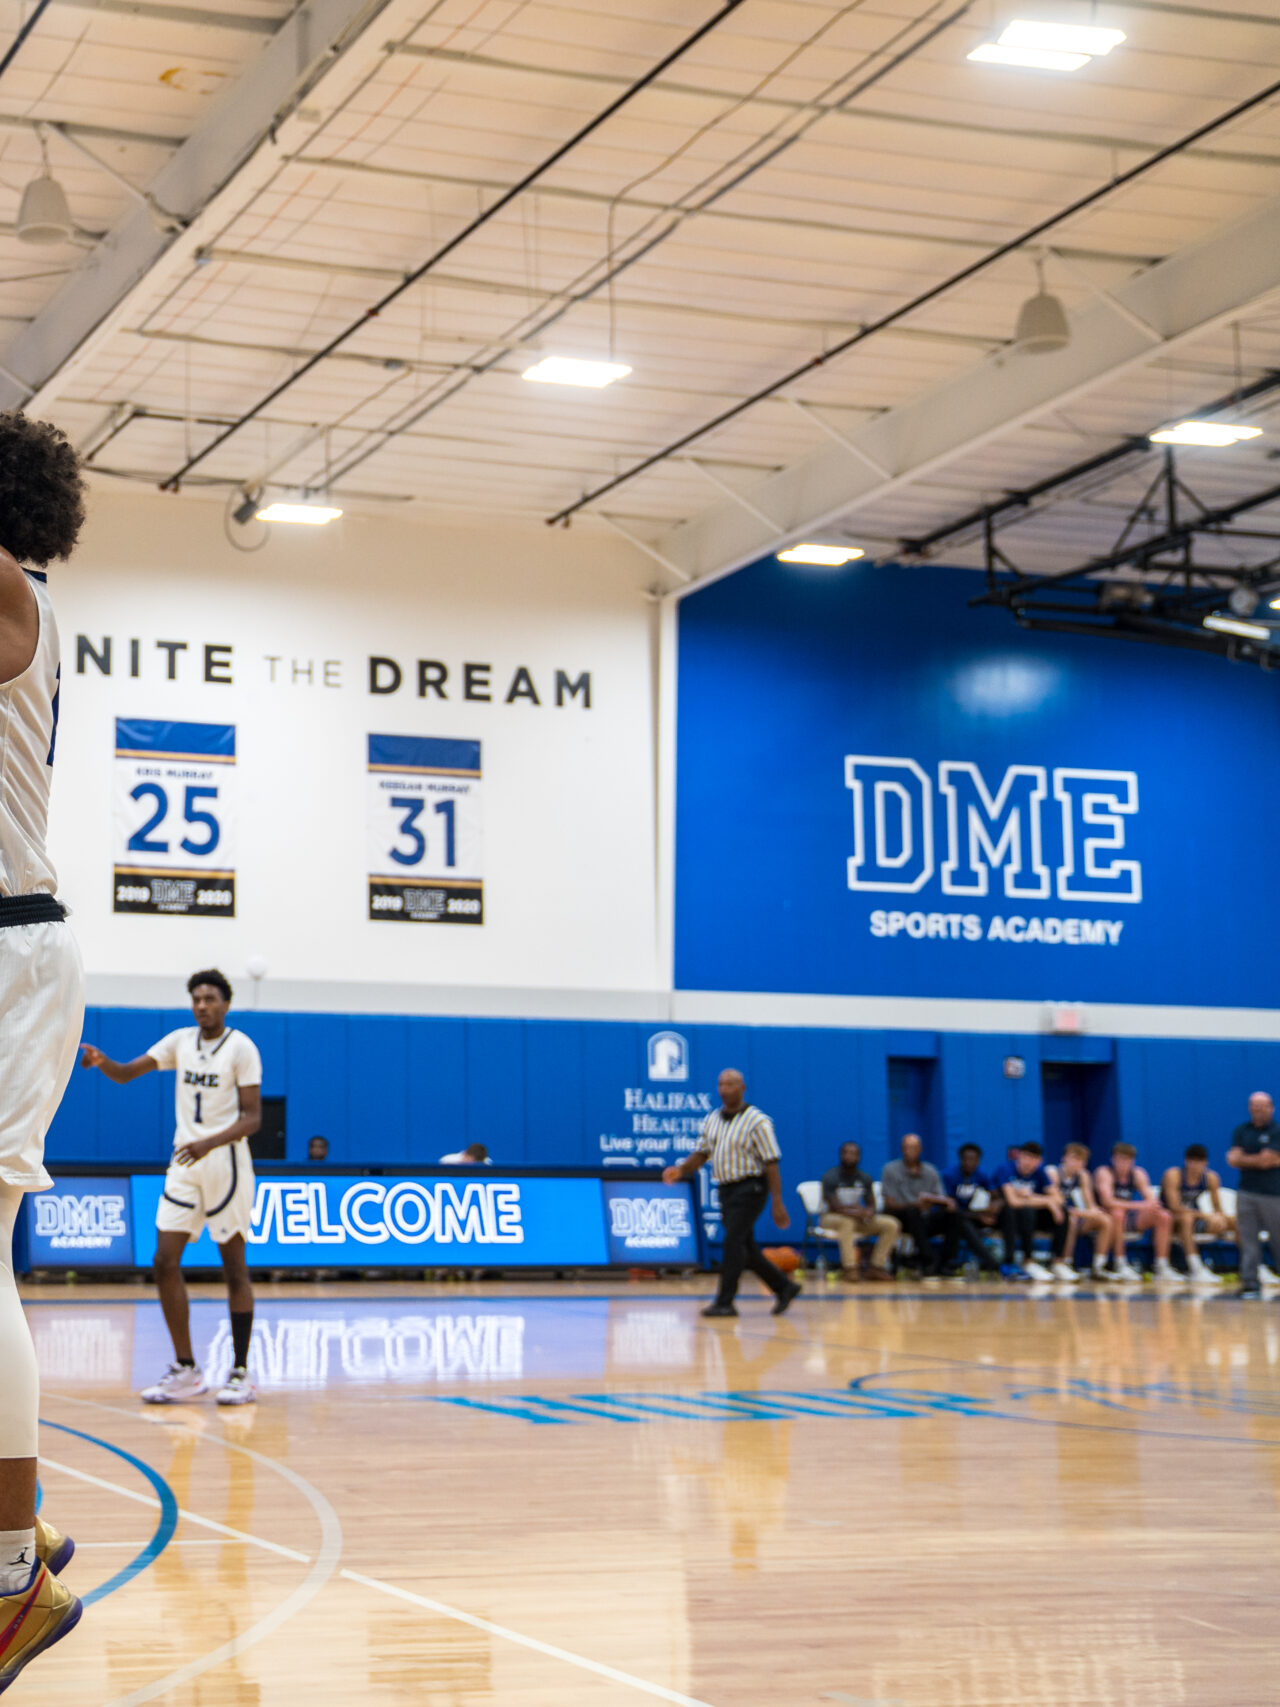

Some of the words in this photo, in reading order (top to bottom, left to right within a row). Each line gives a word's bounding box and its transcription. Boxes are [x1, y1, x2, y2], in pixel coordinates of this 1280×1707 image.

[264, 655, 342, 688] THE
[368, 655, 592, 709] DREAM
[128, 782, 220, 856] 25
[389, 797, 456, 867] 31
[844, 754, 1143, 904] DME
[151, 879, 197, 905] DME
[404, 888, 447, 913] DME
[870, 910, 982, 941] SPORTS
[987, 915, 1123, 946] ACADEMY
[183, 1070, 219, 1088] DME
[194, 1091, 202, 1124] 1
[624, 1087, 712, 1112] HALIFAX
[632, 1113, 706, 1135] HEALTH
[599, 1134, 632, 1150] Live
[635, 1136, 670, 1155] your
[34, 1195, 126, 1236] DME
[609, 1198, 691, 1237] DME
